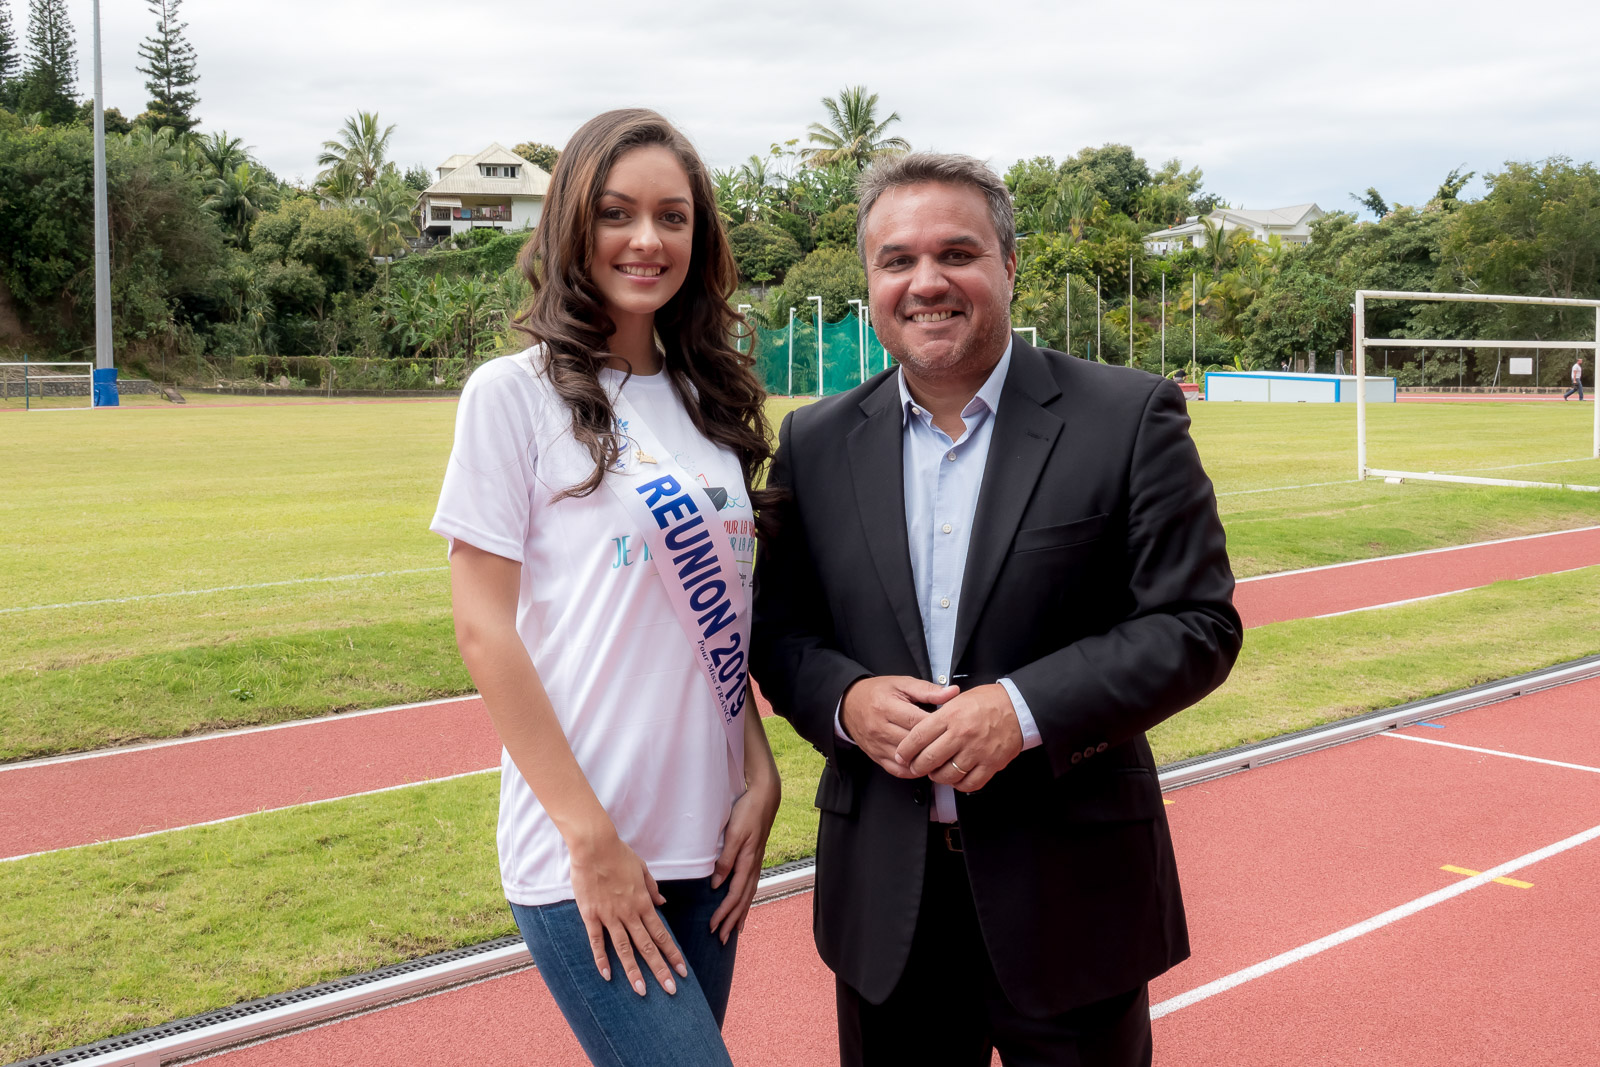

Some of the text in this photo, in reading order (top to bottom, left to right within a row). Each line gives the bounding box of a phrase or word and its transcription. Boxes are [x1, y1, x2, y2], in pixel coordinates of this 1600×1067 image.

[611, 534, 634, 569] JE
[636, 474, 746, 717] REUNION 2019
[698, 639, 733, 725] Pour Miss FRANCE
